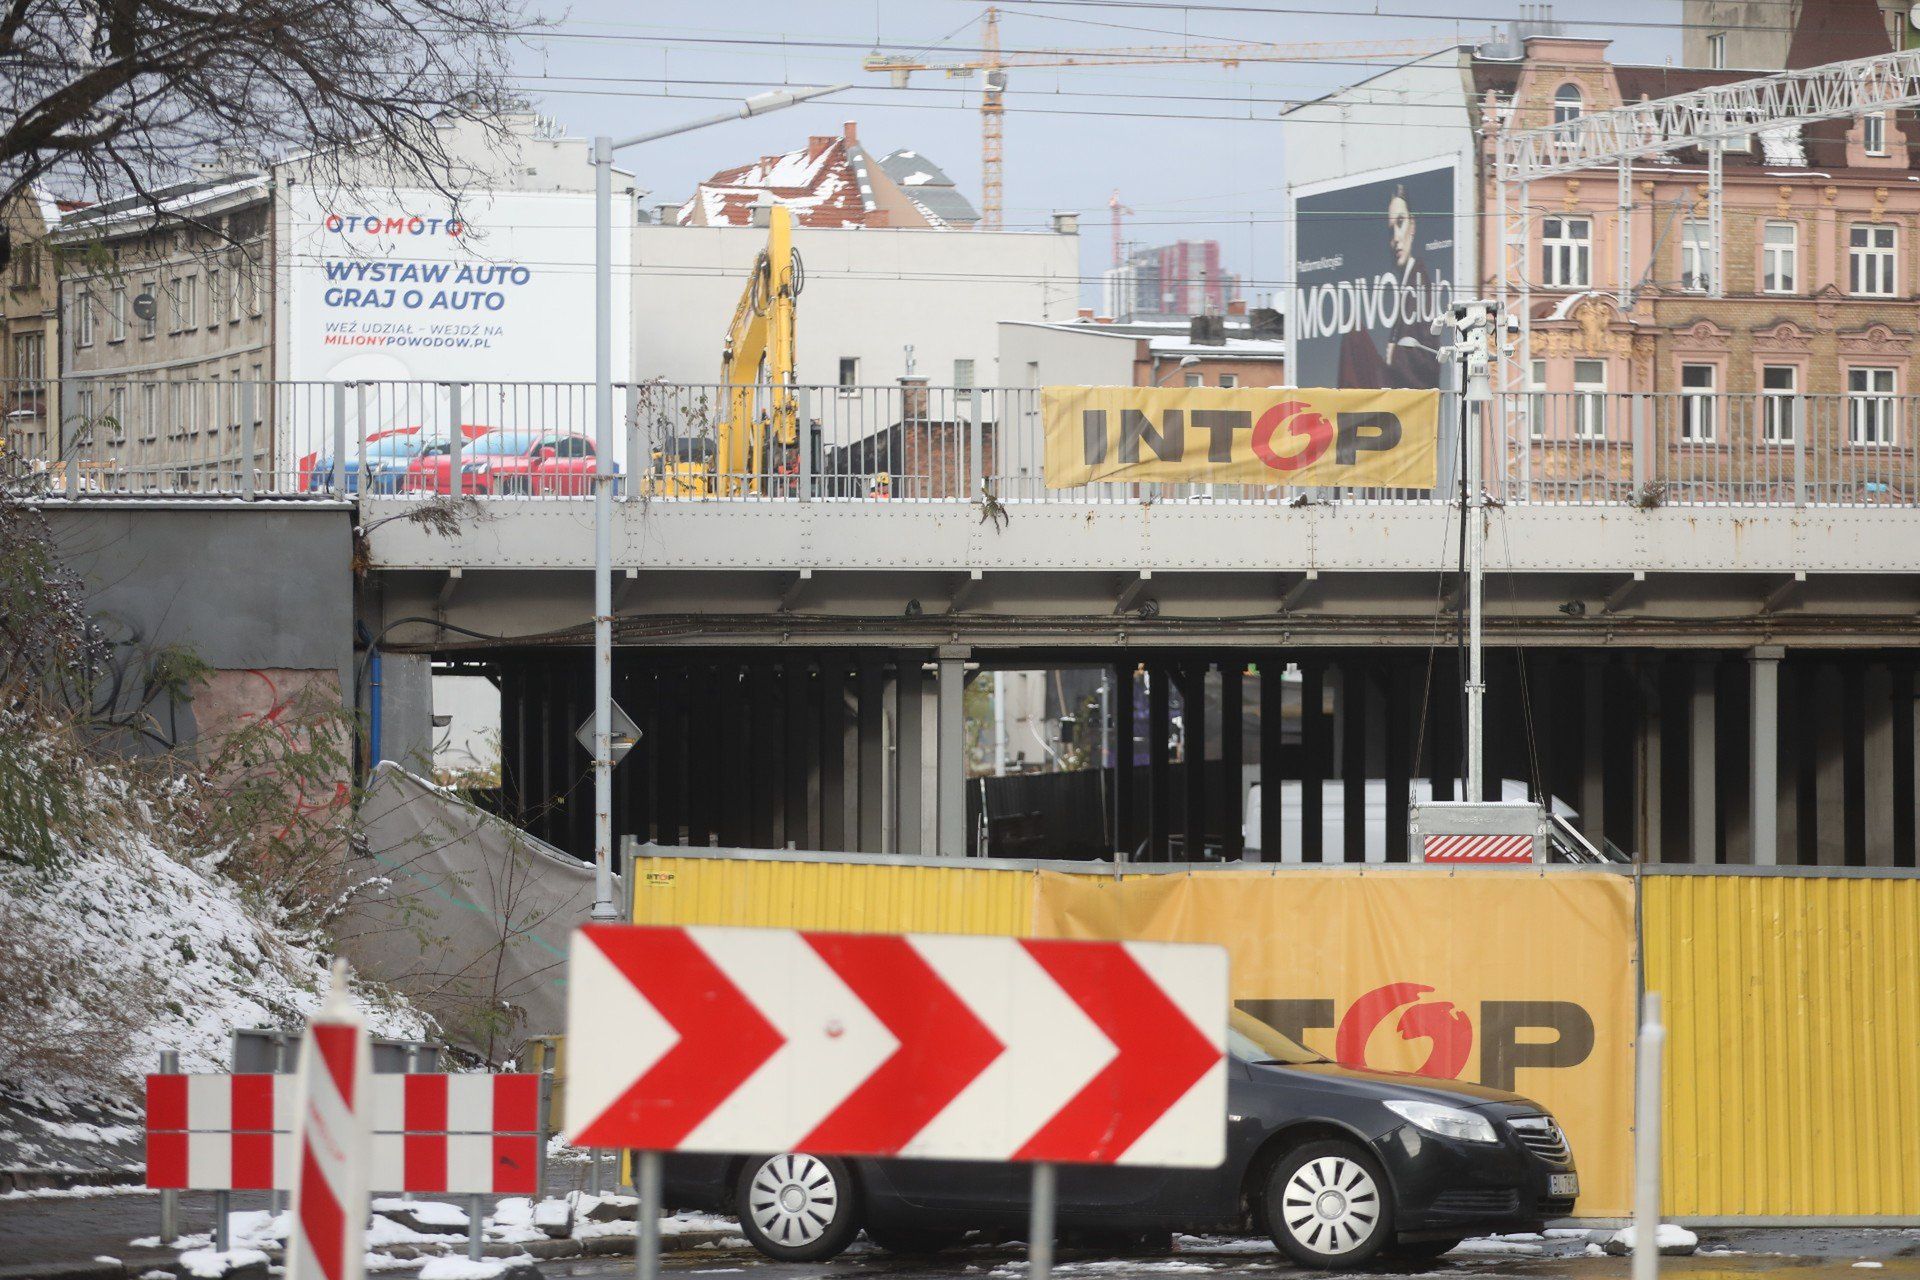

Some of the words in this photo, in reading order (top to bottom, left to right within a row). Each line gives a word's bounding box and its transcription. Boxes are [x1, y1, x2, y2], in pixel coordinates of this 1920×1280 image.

[326, 214, 464, 237] OTOMOTO
[325, 261, 450, 283] WYSTAW
[454, 264, 531, 286] AUTO
[324, 288, 396, 308] GRAJ
[403, 289, 424, 309] O
[429, 290, 505, 311] AUTO
[326, 320, 357, 333] WEŹ
[362, 322, 414, 334] UDZIAŁ
[430, 322, 480, 336] WEJDŹ
[484, 325, 505, 337] NA
[324, 334, 492, 348] MILIONYPOWODOW.PL
[1083, 401, 1403, 471] INTOP
